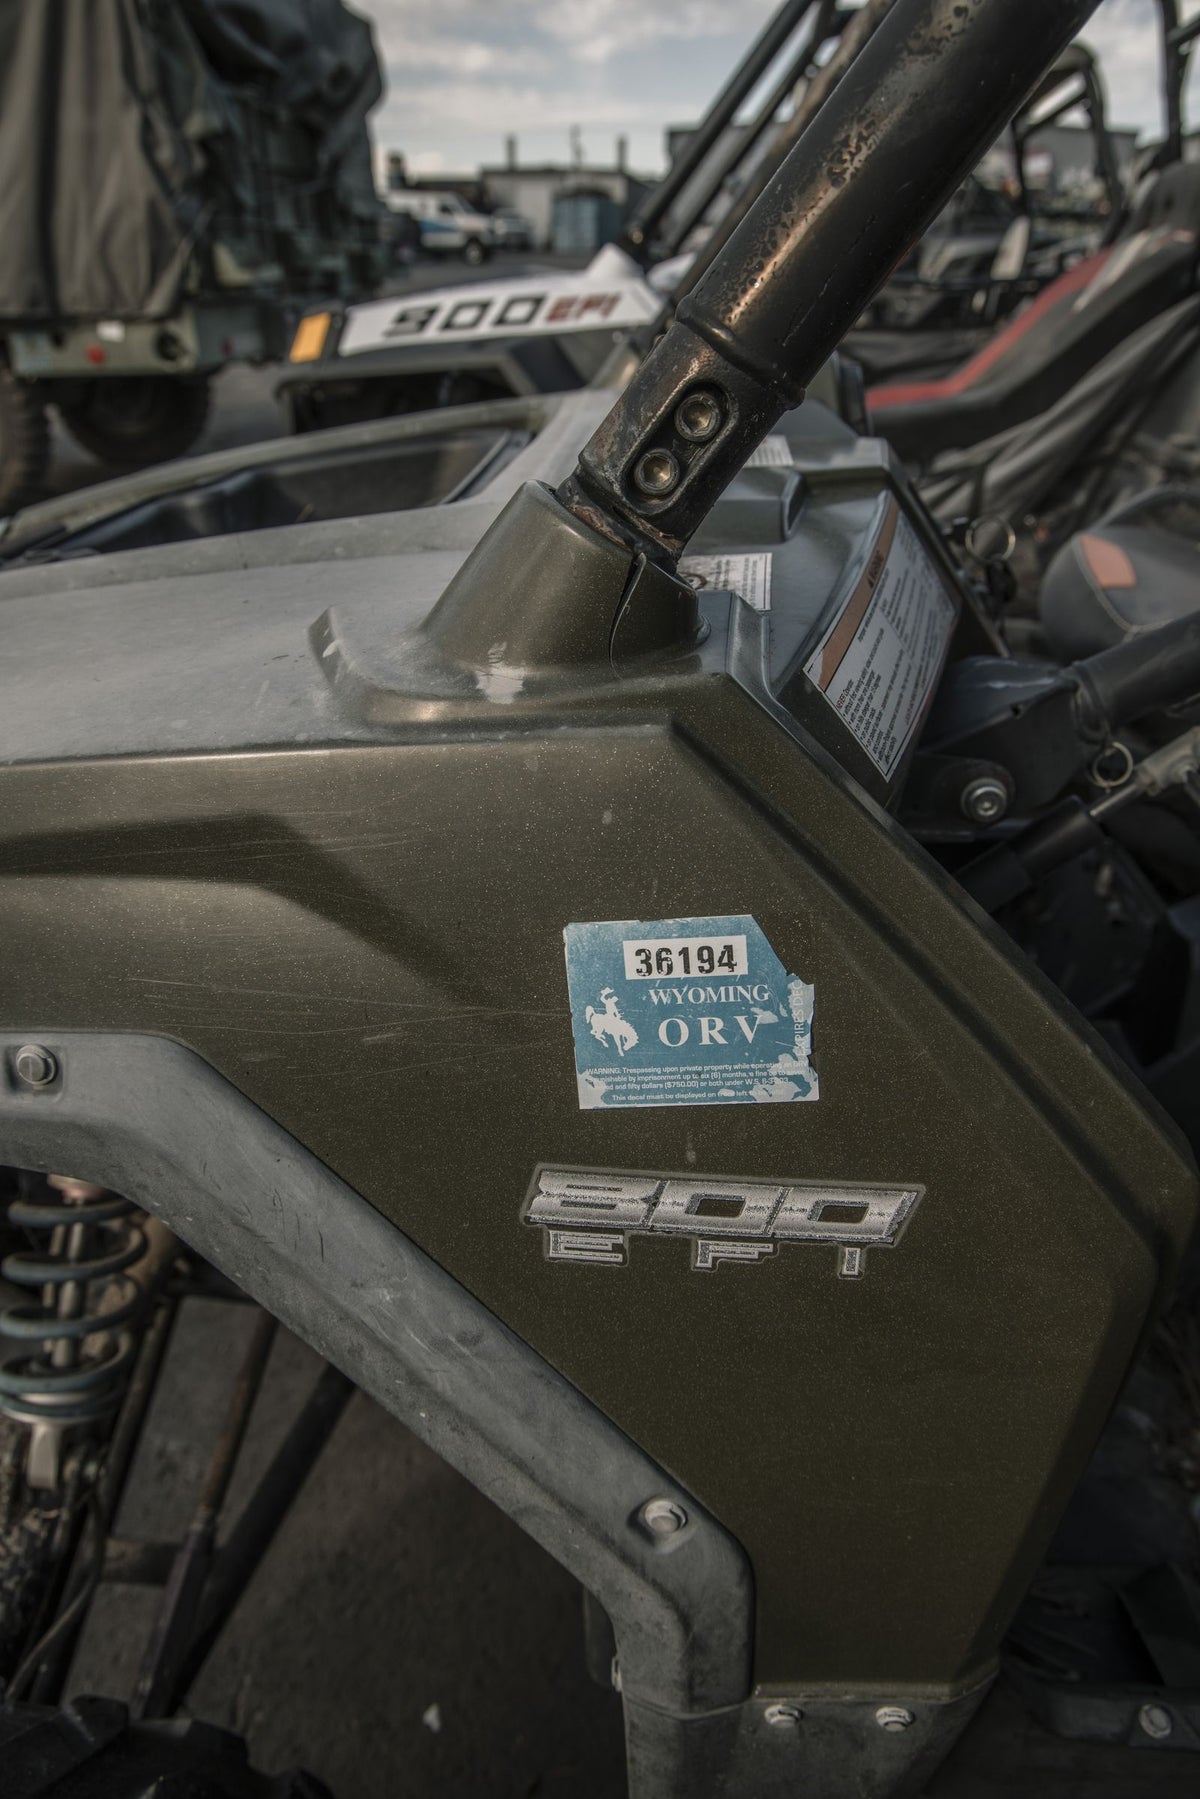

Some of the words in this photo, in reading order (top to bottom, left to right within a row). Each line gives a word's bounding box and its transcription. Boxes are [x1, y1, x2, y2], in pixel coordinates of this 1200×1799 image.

[546, 293, 622, 324] EFI
[635, 944, 737, 976] 36194
[648, 984, 770, 1006] WYOMING
[794, 1008, 805, 1056] EXPIRES
[629, 1075, 636, 1083] by
[683, 1073, 691, 1081] up
[755, 1069, 768, 1077] fine
[662, 1065, 679, 1074] upon
[680, 1064, 703, 1073] private
[704, 1063, 732, 1072] property
[733, 1062, 750, 1070] while
[627, 1082, 640, 1091] fifty
[641, 1082, 664, 1090] dollars
[664, 1080, 699, 1090] ($750.00)
[708, 1078, 724, 1087] both
[725, 1078, 743, 1086] under
[628, 1093, 645, 1101] decal
[647, 1092, 664, 1101] must
[665, 1091, 674, 1099] be
[675, 1090, 707, 1100] displayed
